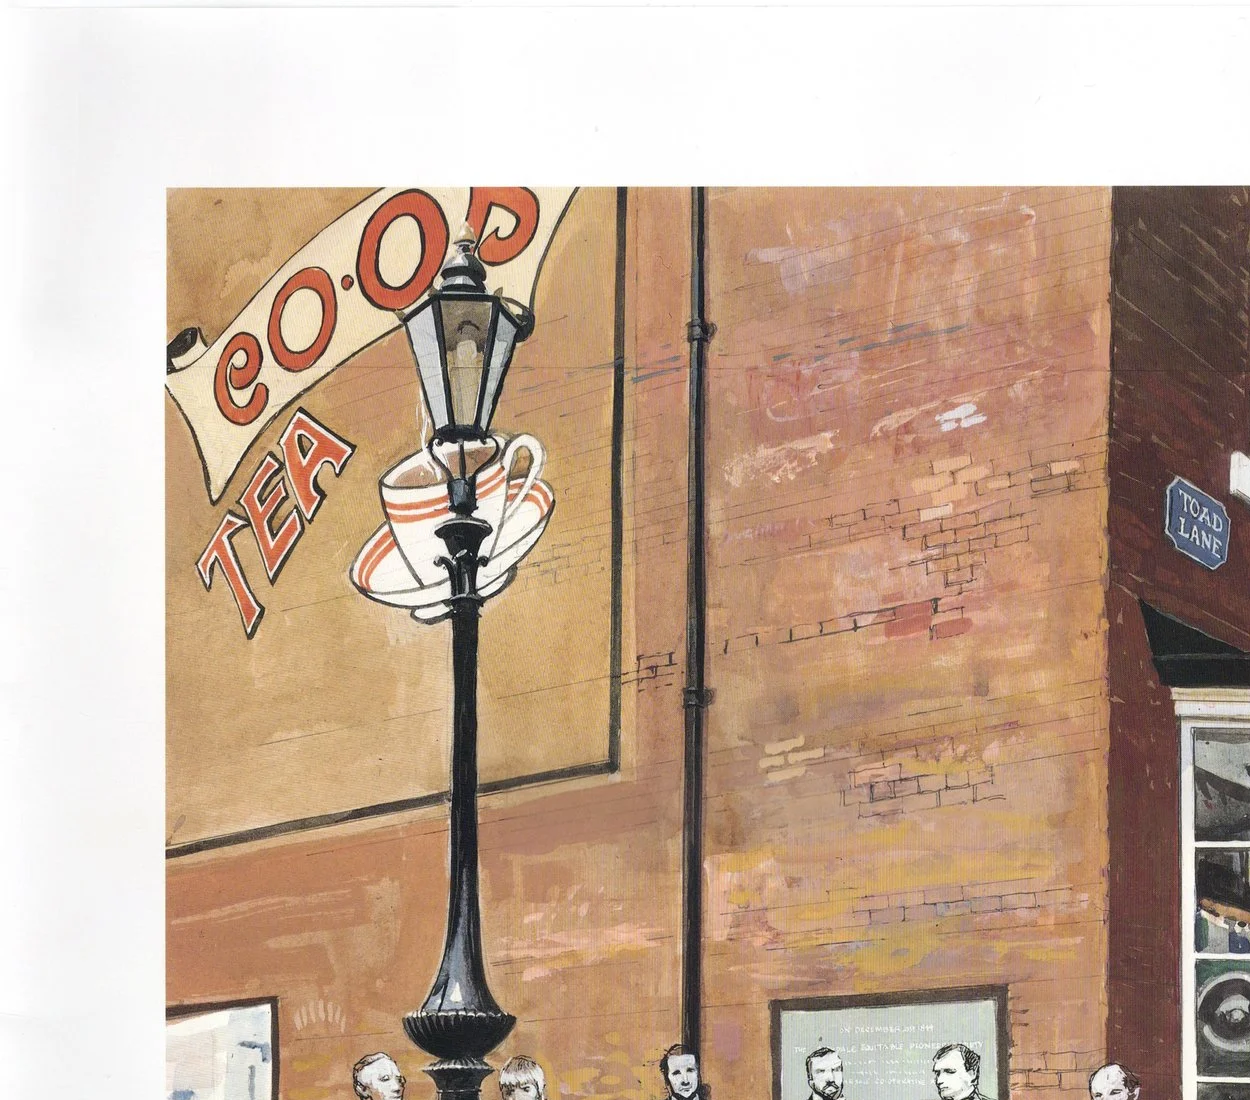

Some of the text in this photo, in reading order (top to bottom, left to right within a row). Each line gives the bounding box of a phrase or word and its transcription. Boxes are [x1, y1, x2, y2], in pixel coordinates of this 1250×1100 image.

[196, 407, 356, 640] TEA
[1178, 488, 1223, 532] TOAD
[1177, 516, 1223, 559] LANE
